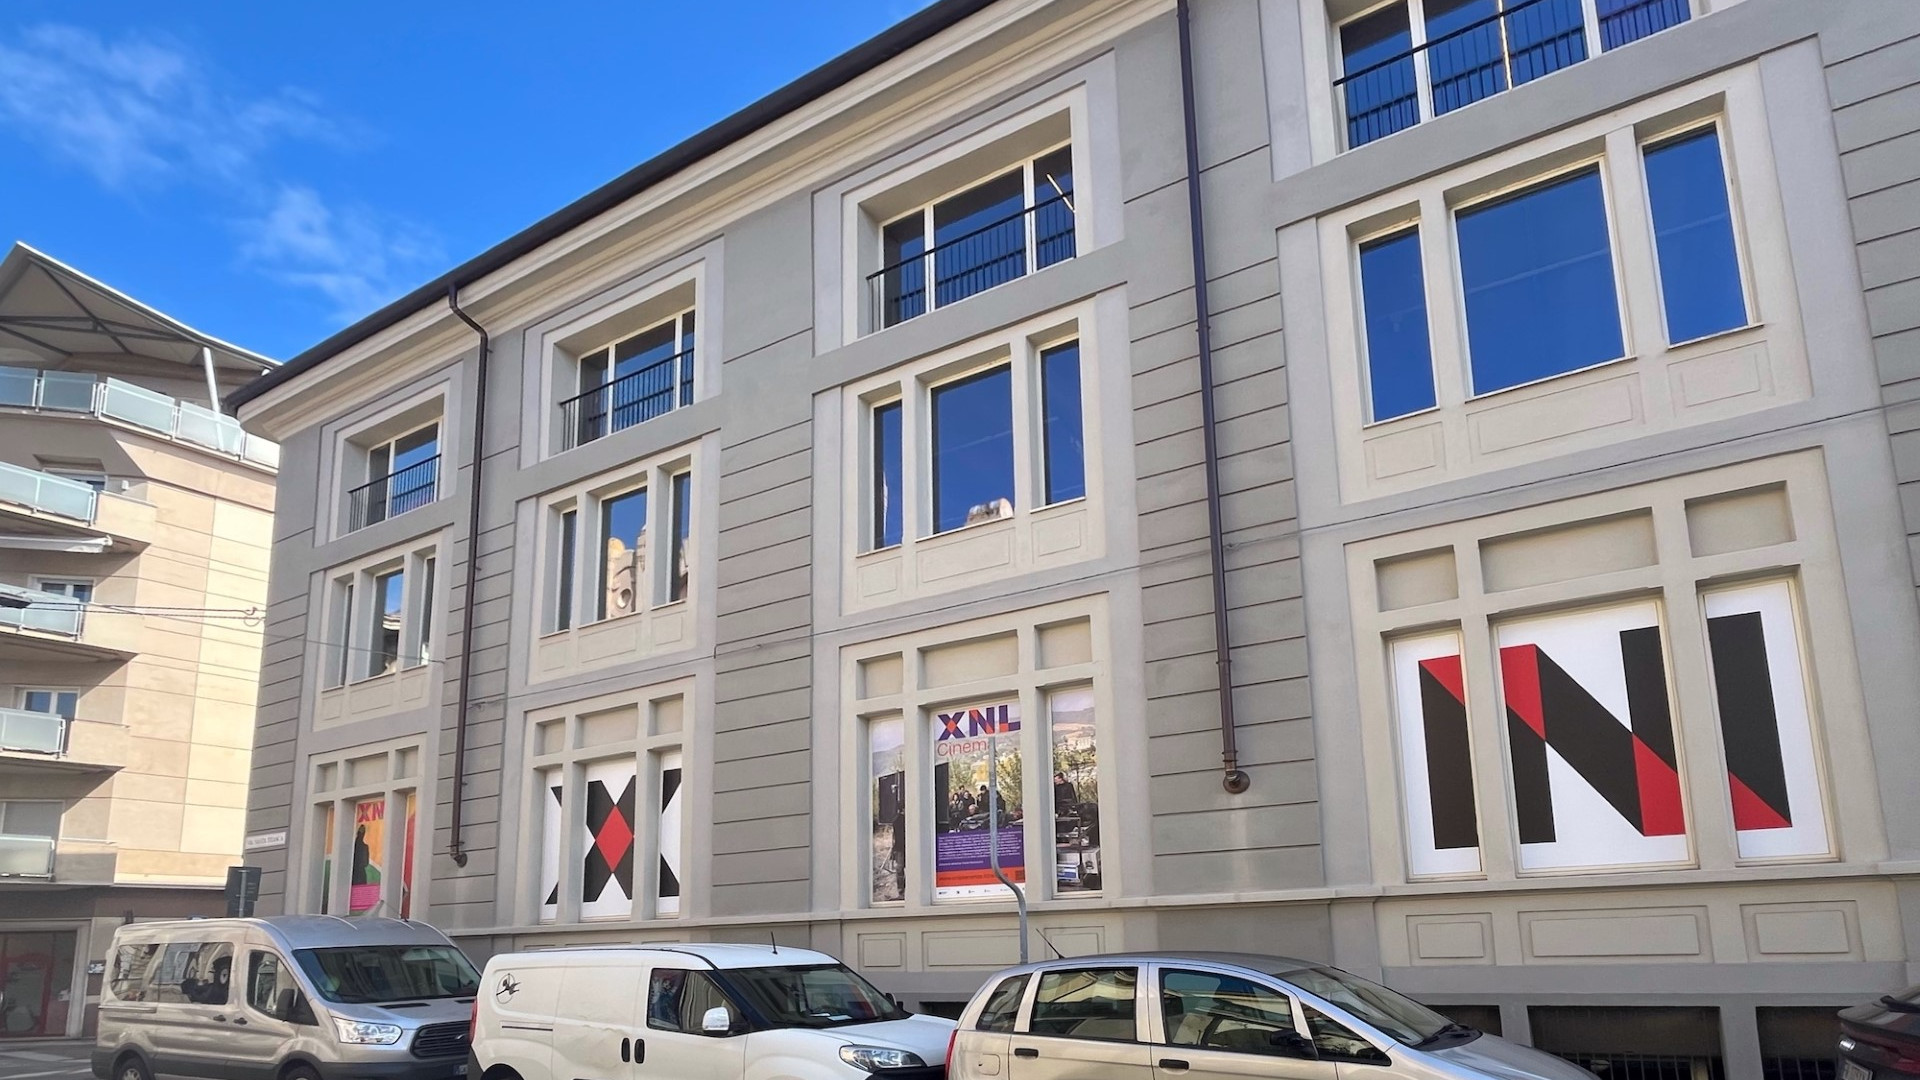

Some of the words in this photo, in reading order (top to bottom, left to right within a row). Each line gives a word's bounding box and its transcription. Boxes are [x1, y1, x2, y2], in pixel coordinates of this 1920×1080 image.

[937, 705, 1021, 741] XNL
[937, 740, 990, 756] Cinem
[358, 800, 385, 823] XN
